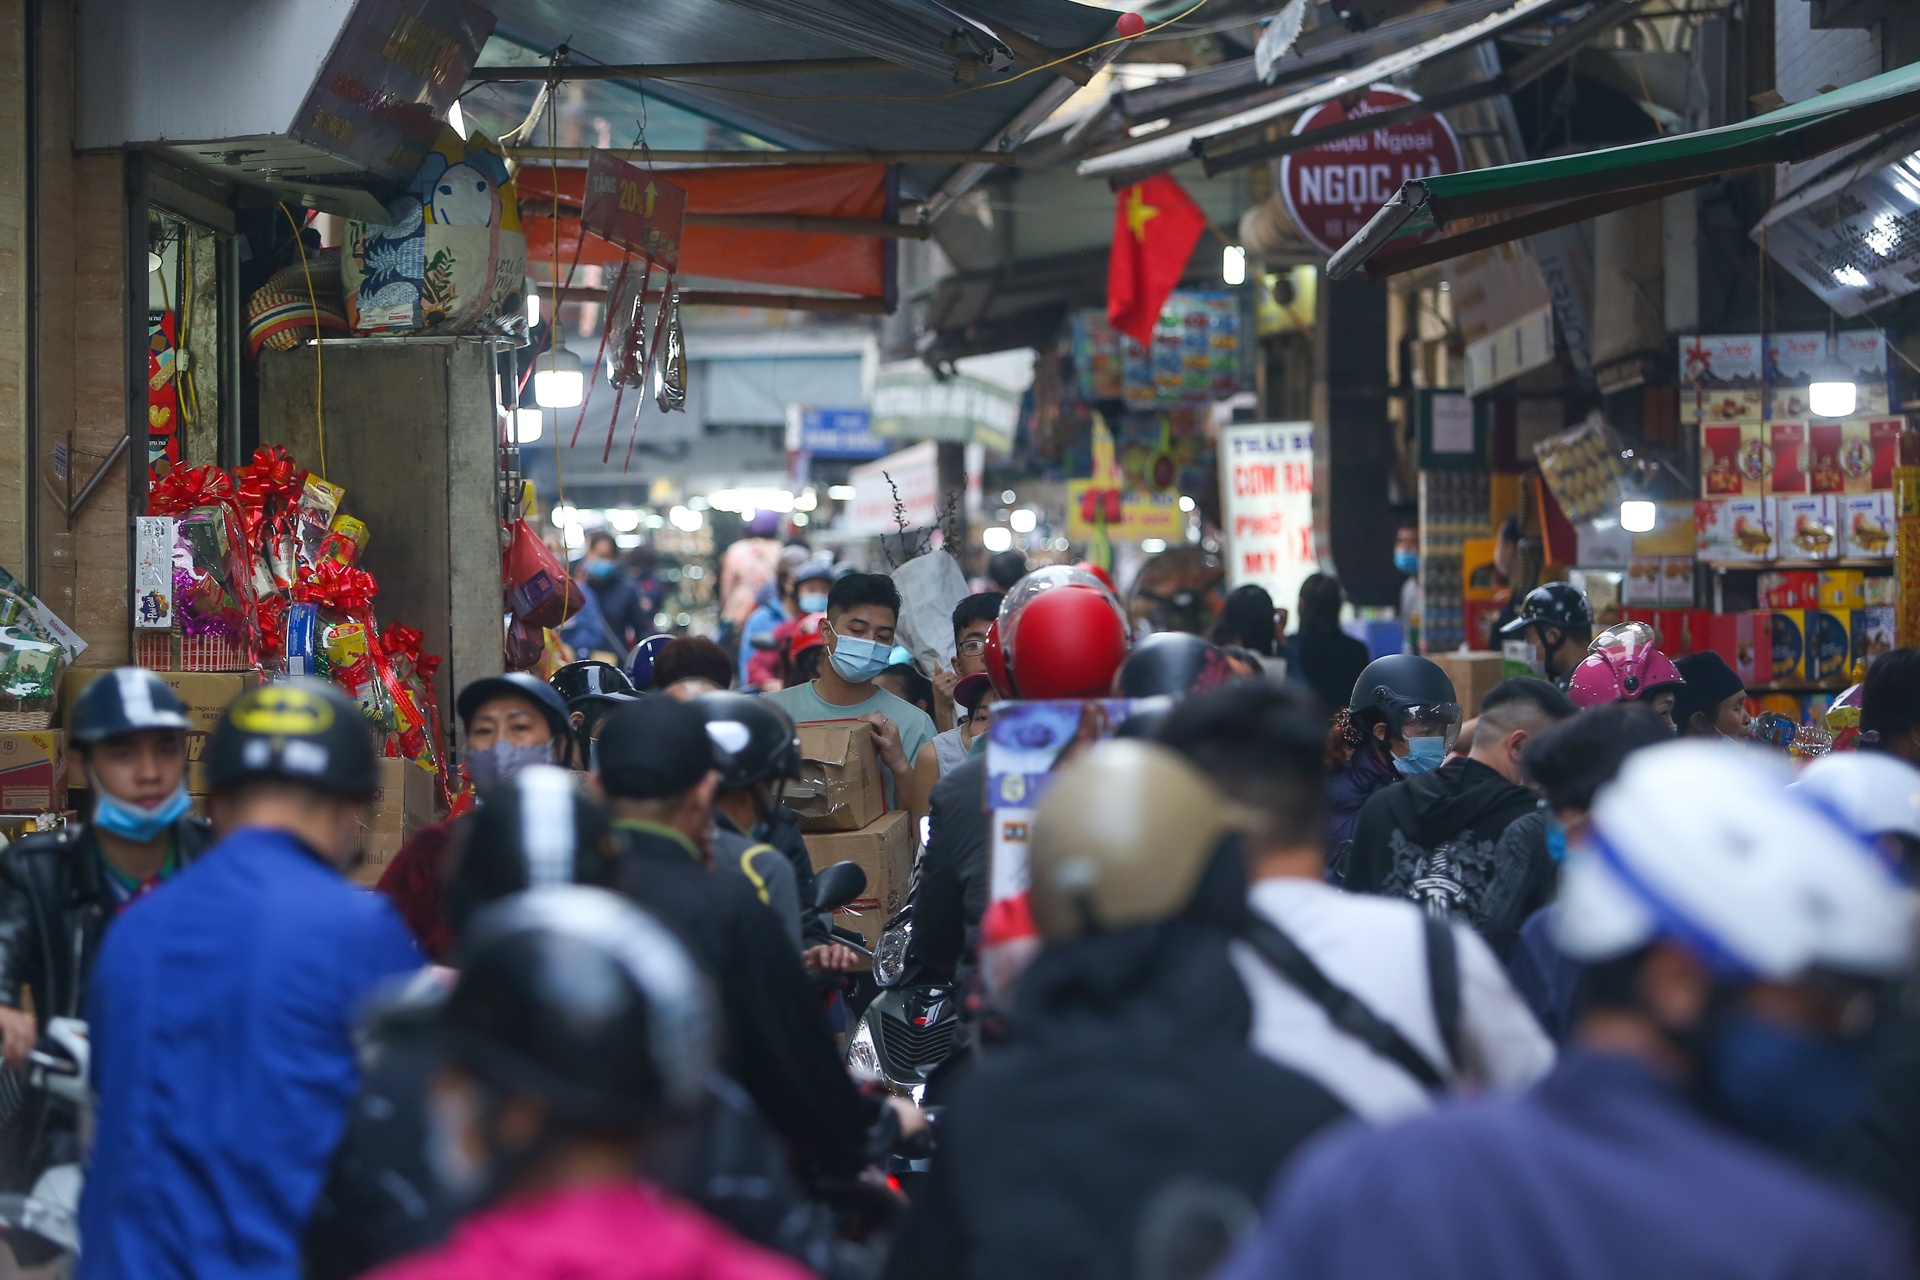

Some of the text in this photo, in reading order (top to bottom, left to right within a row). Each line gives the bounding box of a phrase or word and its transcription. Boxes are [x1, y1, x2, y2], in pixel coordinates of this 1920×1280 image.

[1374, 129, 1434, 154] Ngoại
[1300, 165, 1391, 214] NGỌC
[32, 735, 49, 750] NEW
